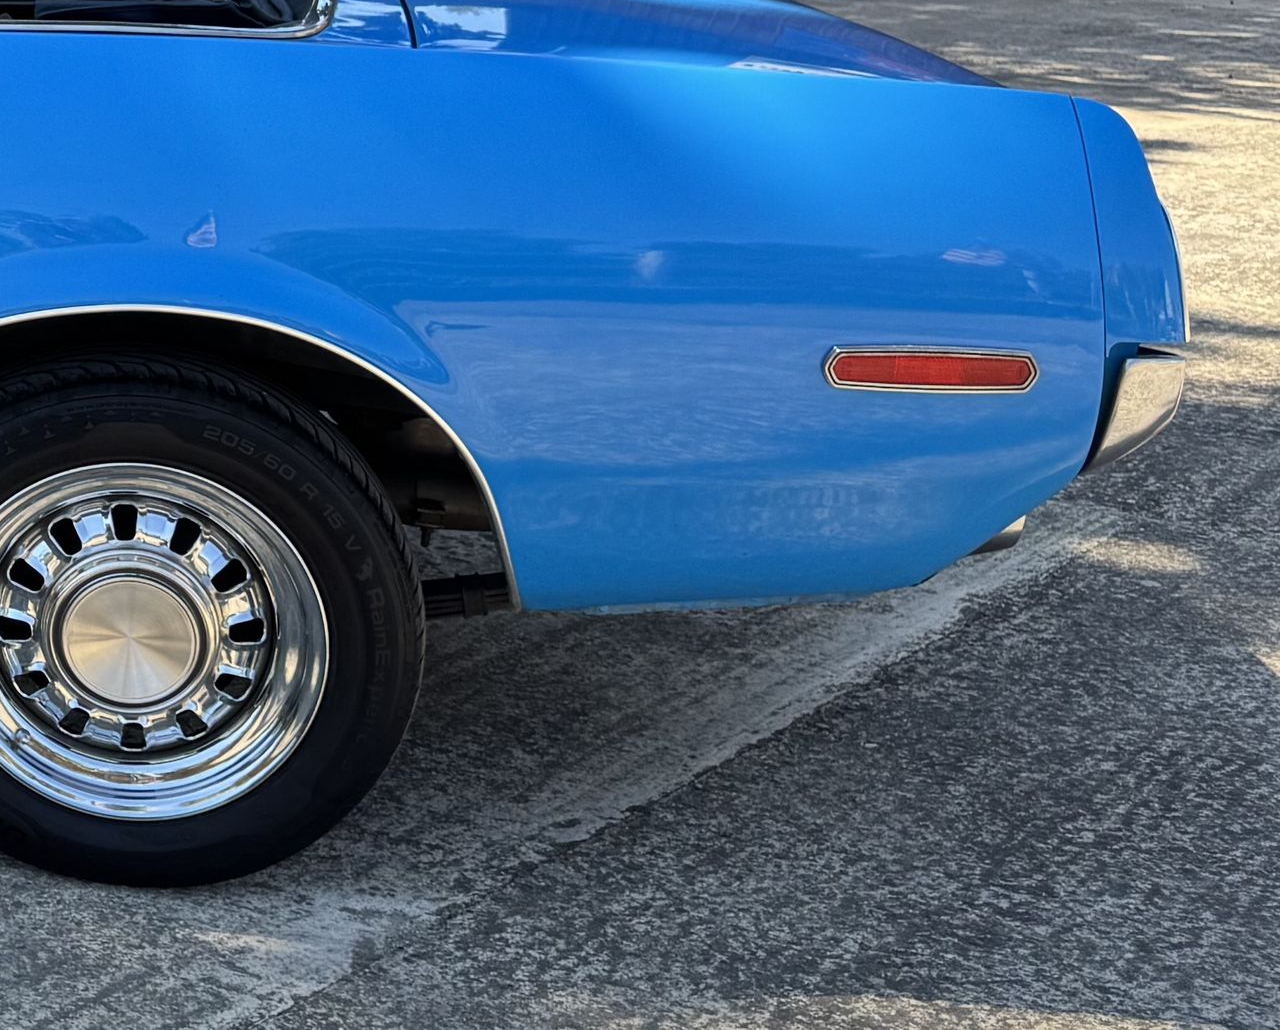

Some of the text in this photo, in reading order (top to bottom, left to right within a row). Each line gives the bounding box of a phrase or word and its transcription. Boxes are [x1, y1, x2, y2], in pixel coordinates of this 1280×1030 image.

[202, 424, 298, 482] 205/60
[298, 481, 321, 501] R
[322, 502, 346, 530] 15
